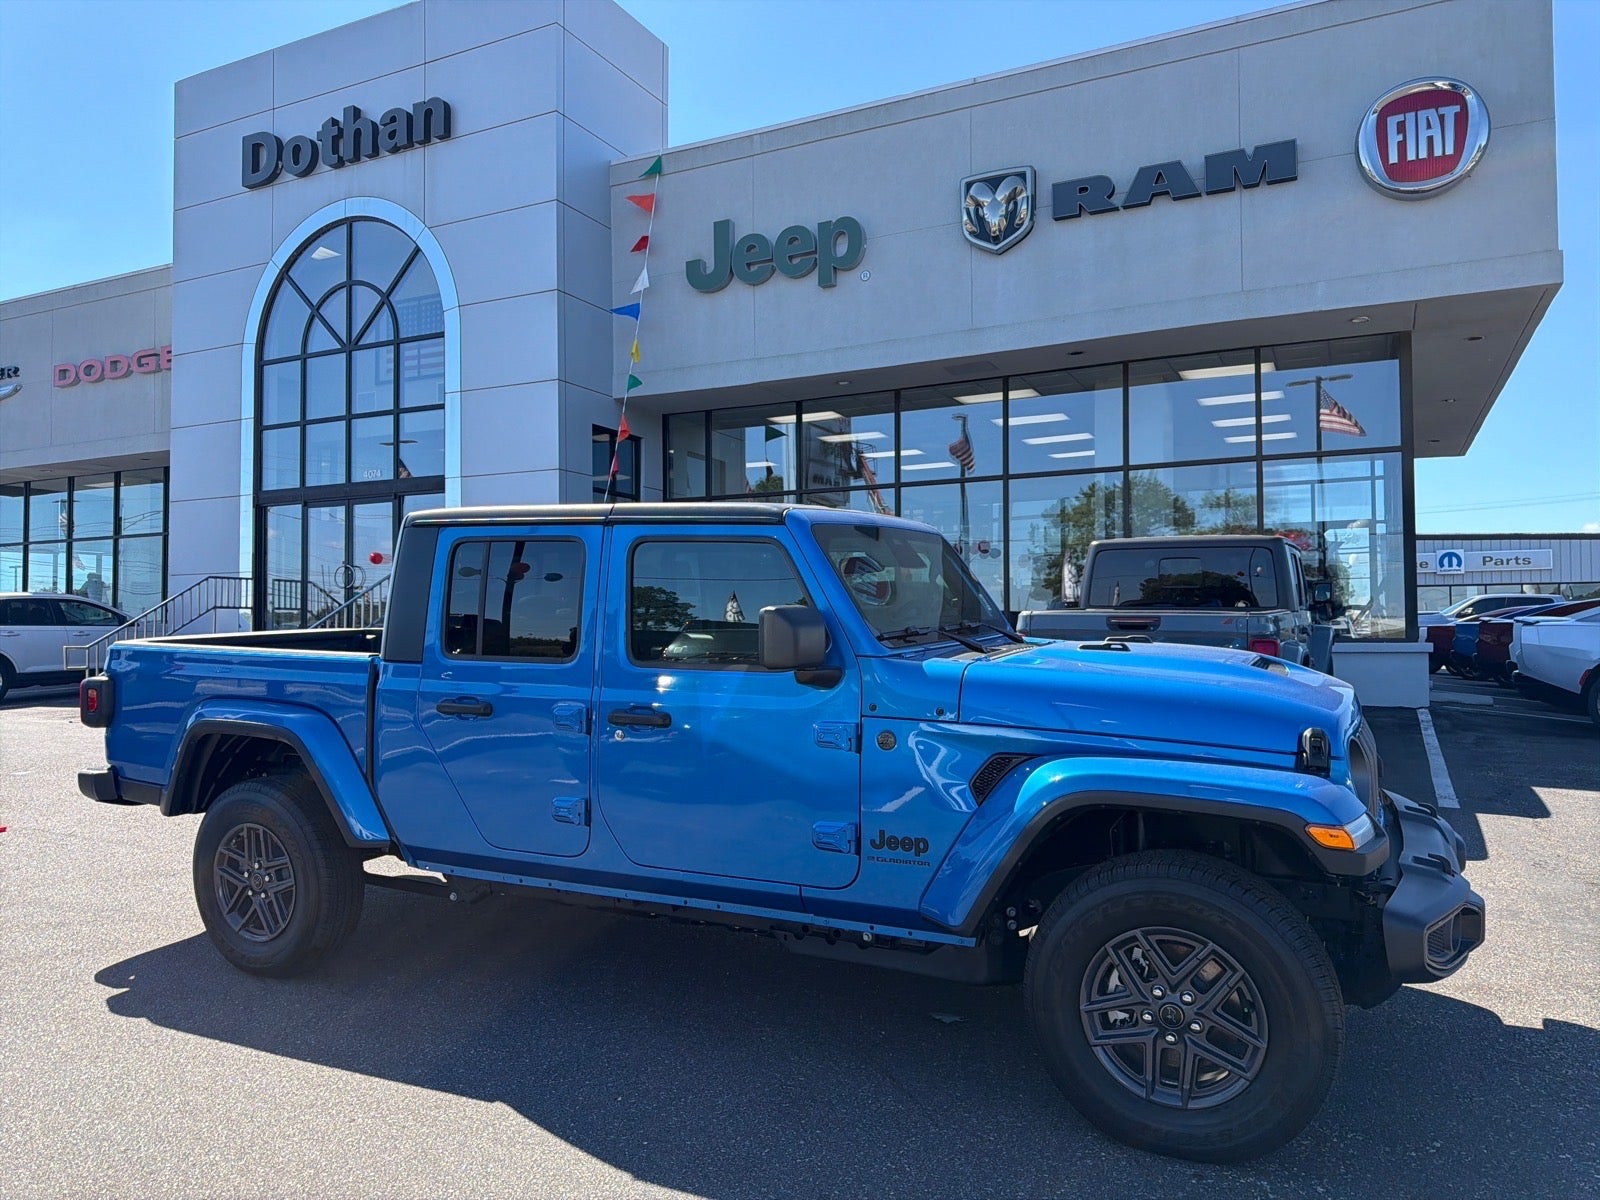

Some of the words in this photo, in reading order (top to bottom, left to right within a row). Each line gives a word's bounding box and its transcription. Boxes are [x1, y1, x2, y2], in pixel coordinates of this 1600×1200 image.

[242, 97, 451, 189] Dothan
[1387, 105, 1461, 165] FIAT
[1052, 138, 1298, 221] RAM
[686, 216, 867, 294] Jeep
[53, 345, 172, 388] DODGE
[1482, 556, 1532, 567] Parts
[869, 829, 929, 857] Jeep
